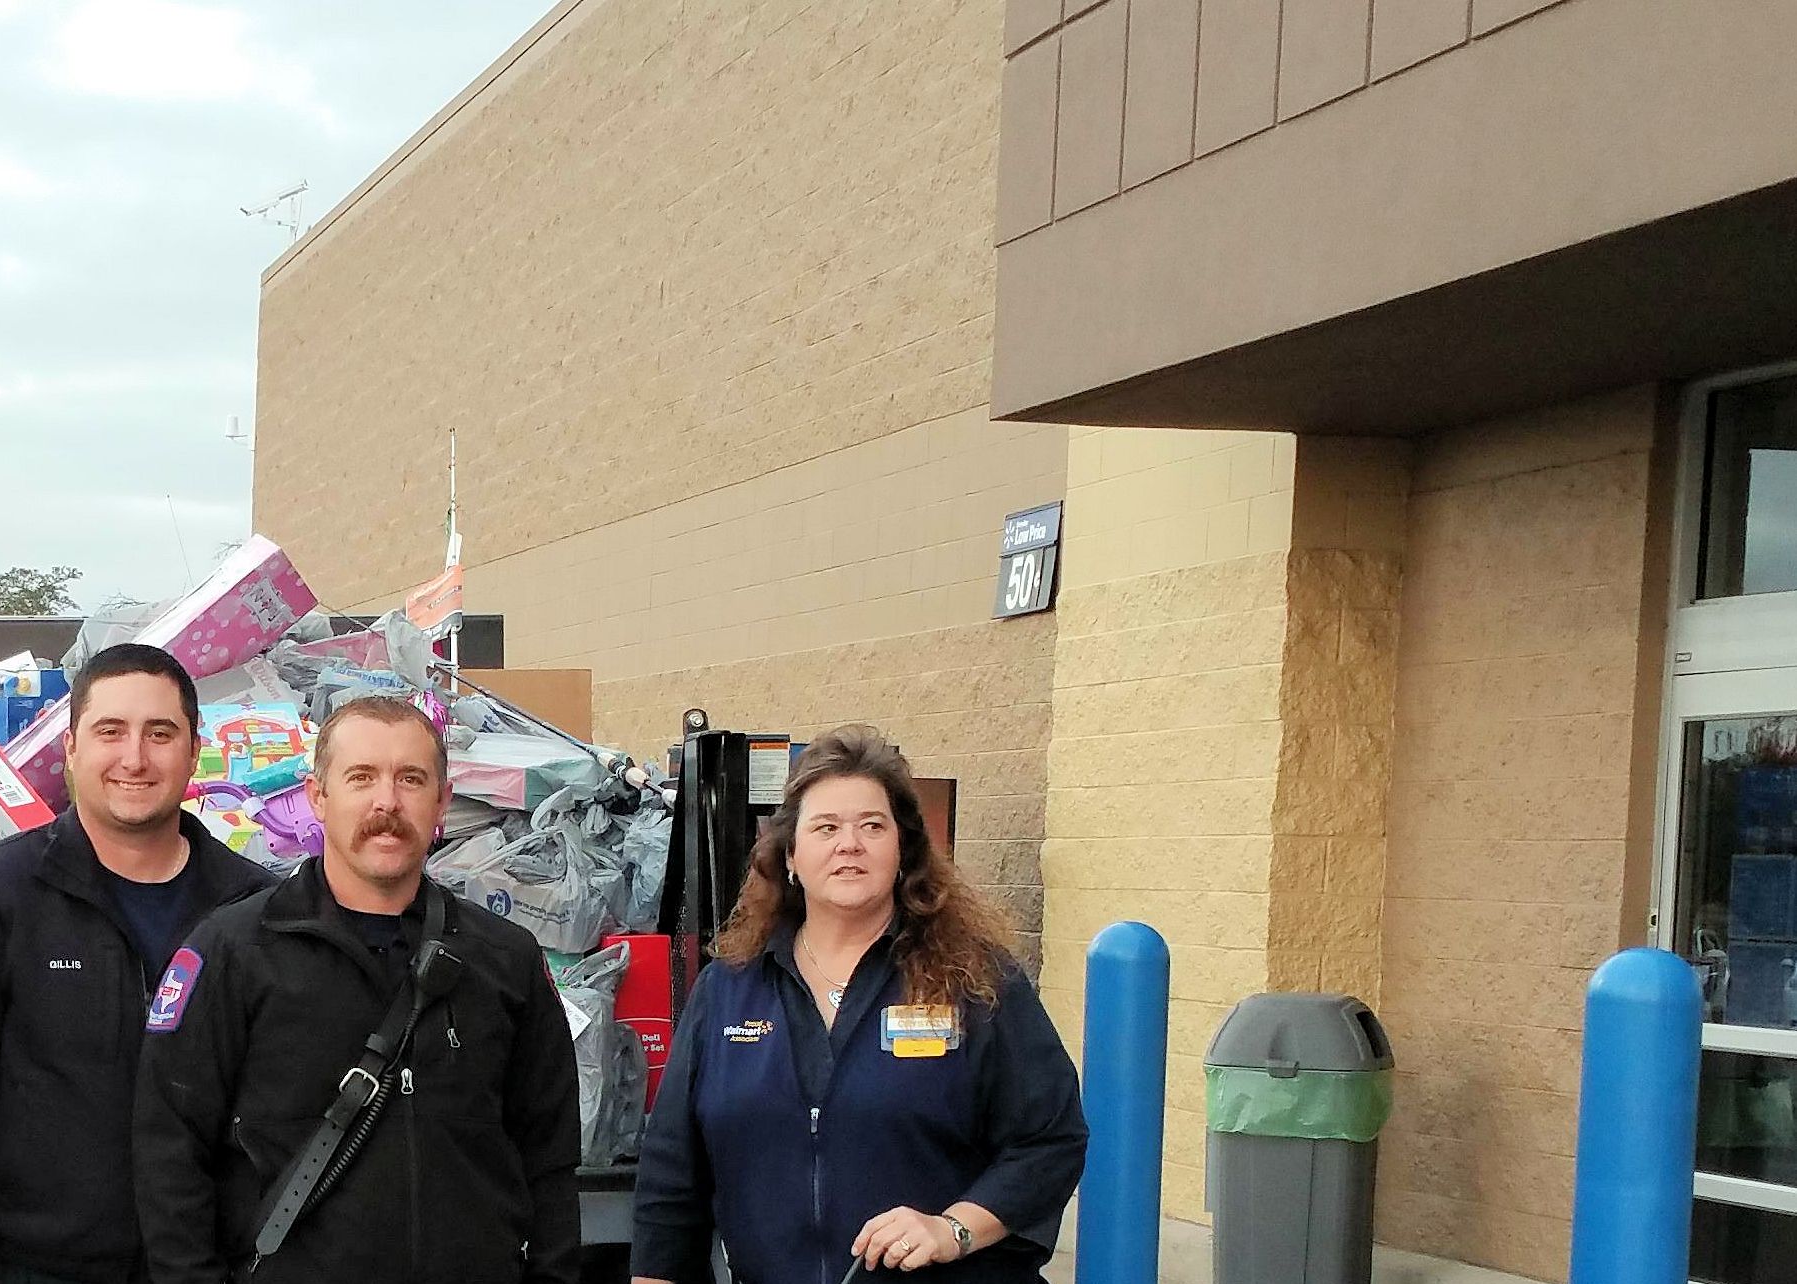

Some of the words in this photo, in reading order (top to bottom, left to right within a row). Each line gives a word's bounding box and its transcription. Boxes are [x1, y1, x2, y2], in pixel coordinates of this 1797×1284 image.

[1029, 523, 1046, 543] Price
[49, 960, 82, 969] GILLIS
[723, 1026, 761, 1036] Walmart
